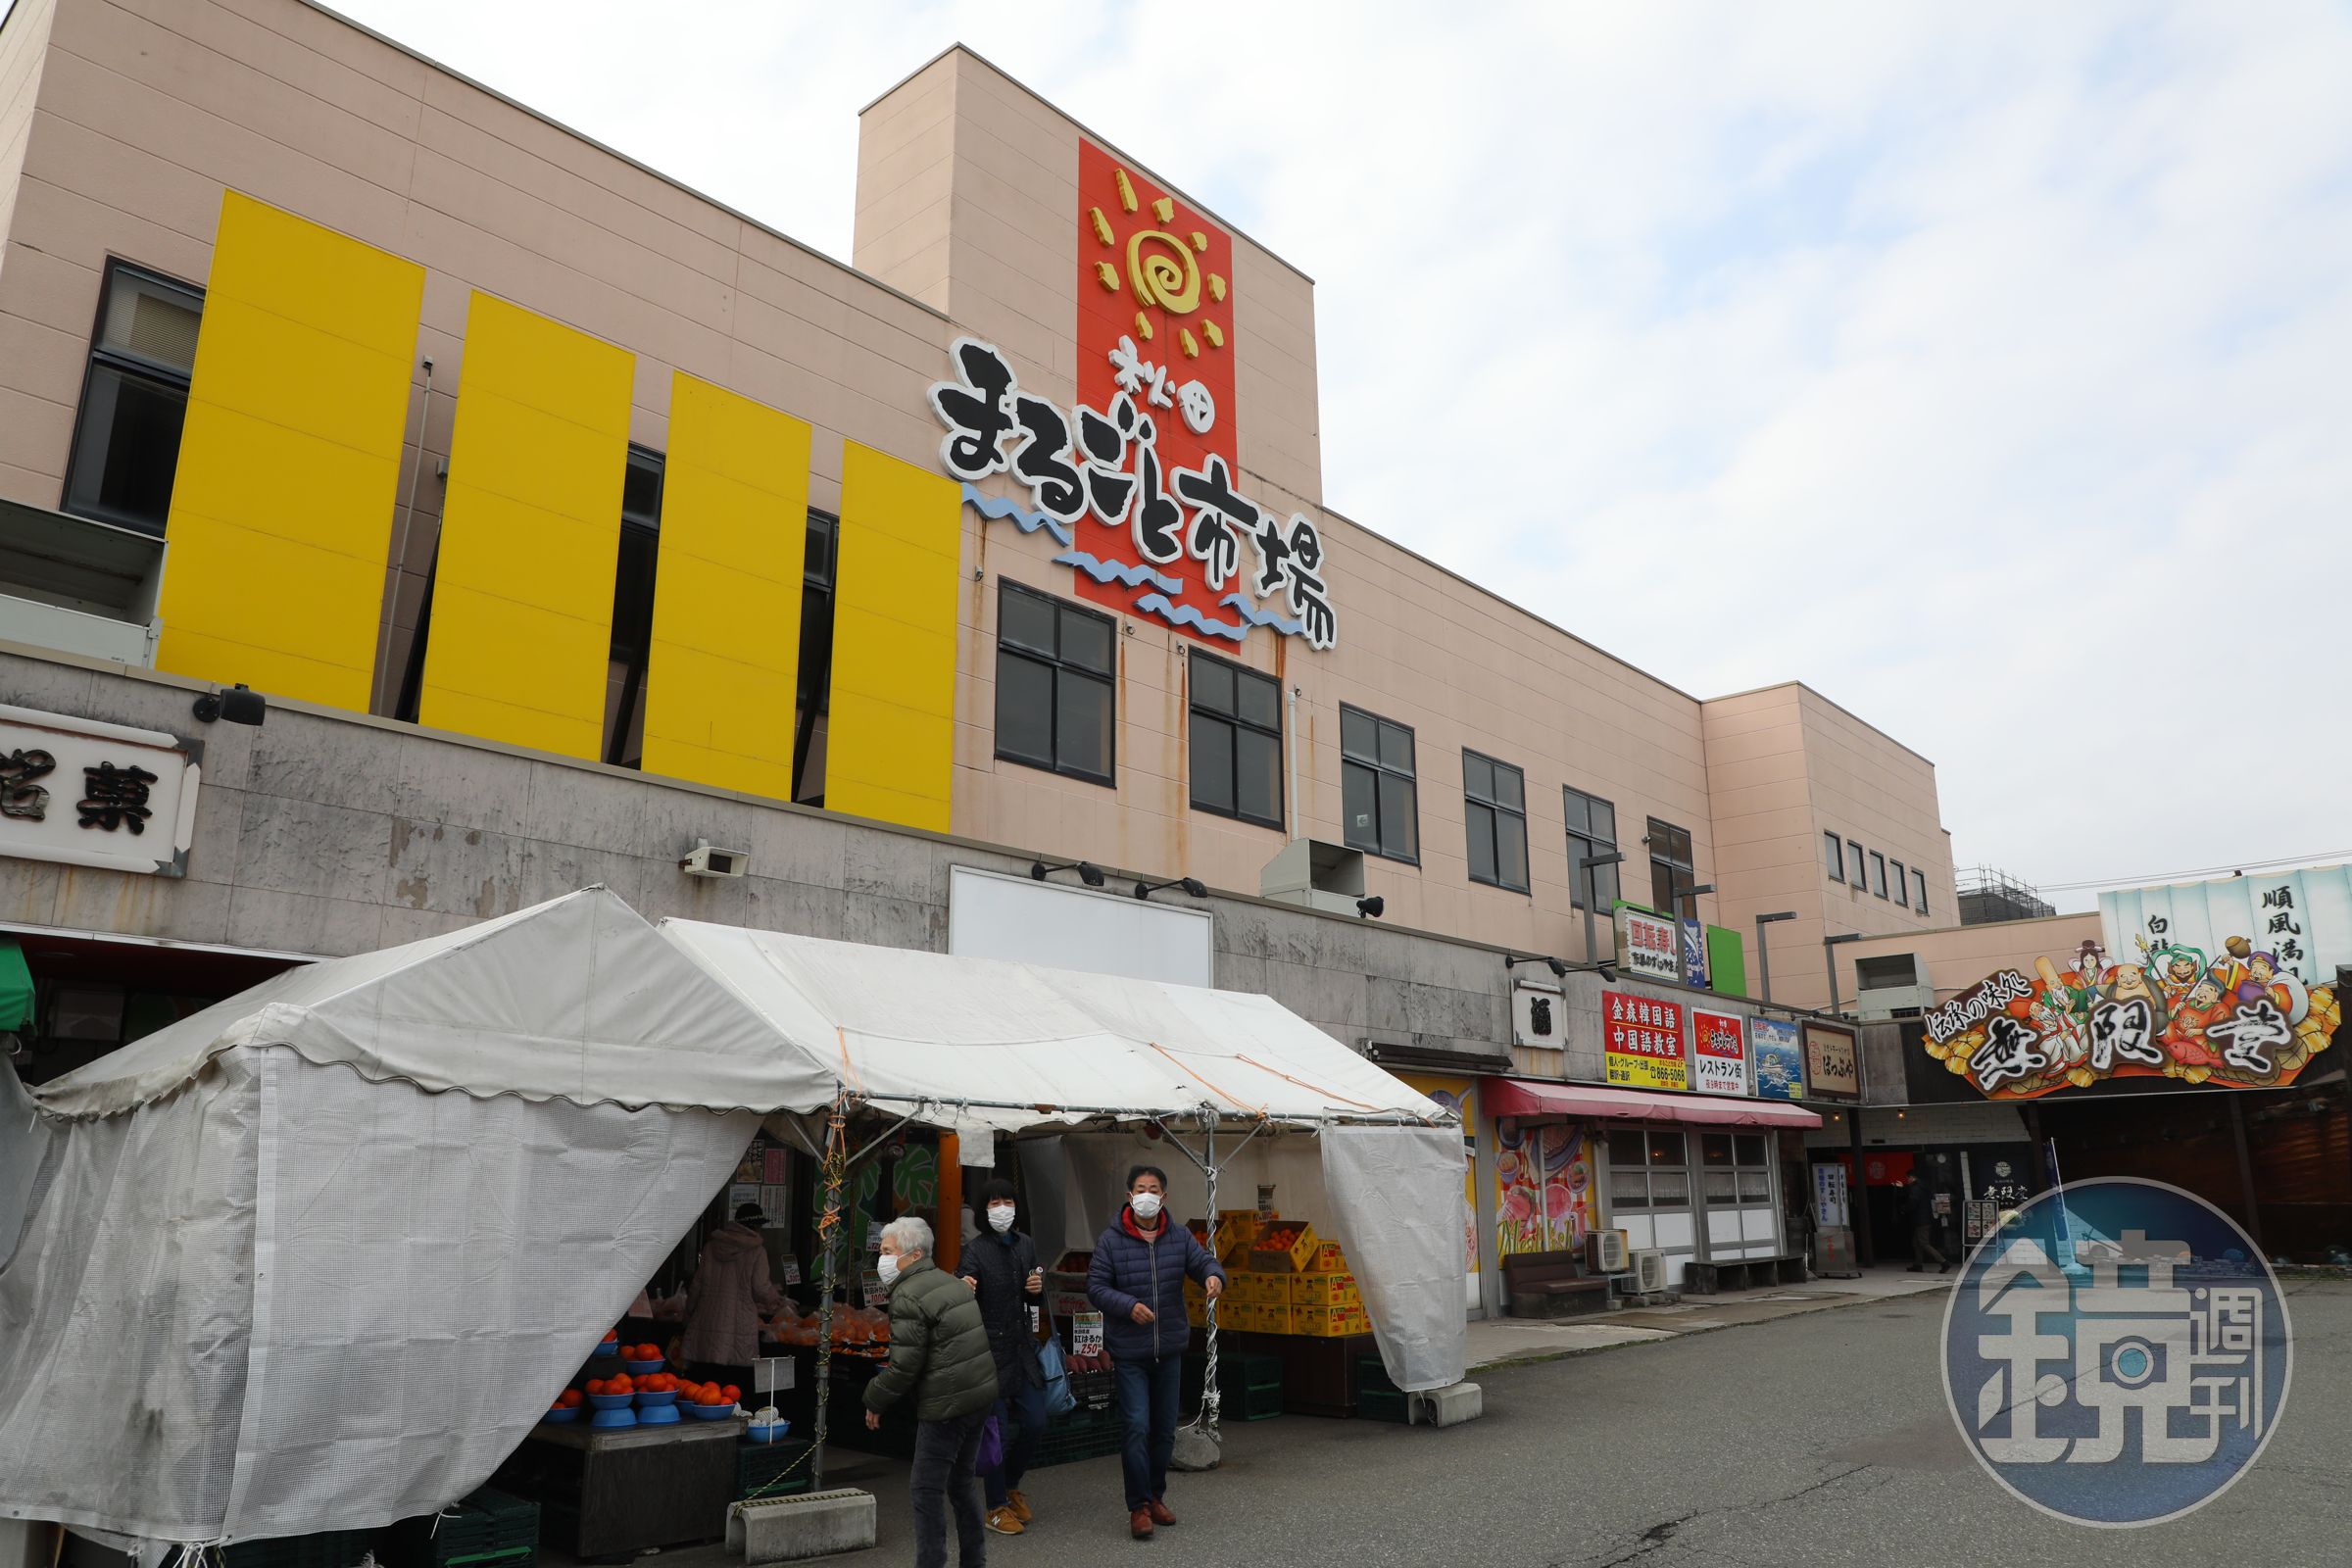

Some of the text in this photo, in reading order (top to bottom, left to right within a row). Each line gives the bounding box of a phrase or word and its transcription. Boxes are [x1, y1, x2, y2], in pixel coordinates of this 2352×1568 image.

[930, 339, 1336, 647] まるごと市場
[1612, 997, 1676, 1029] 金森韓国語
[1926, 971, 2033, 1042] 伝承の味処
[1613, 1026, 1678, 1057] 中国語教室
[1657, 1067, 1686, 1082] 866-5068
[1699, 1059, 1741, 1079] レストラン街
[1827, 1174, 1837, 1203] 回転寿司
[1074, 1335, 1102, 1344] 紅はるか
[1081, 1344, 1099, 1354] 250
